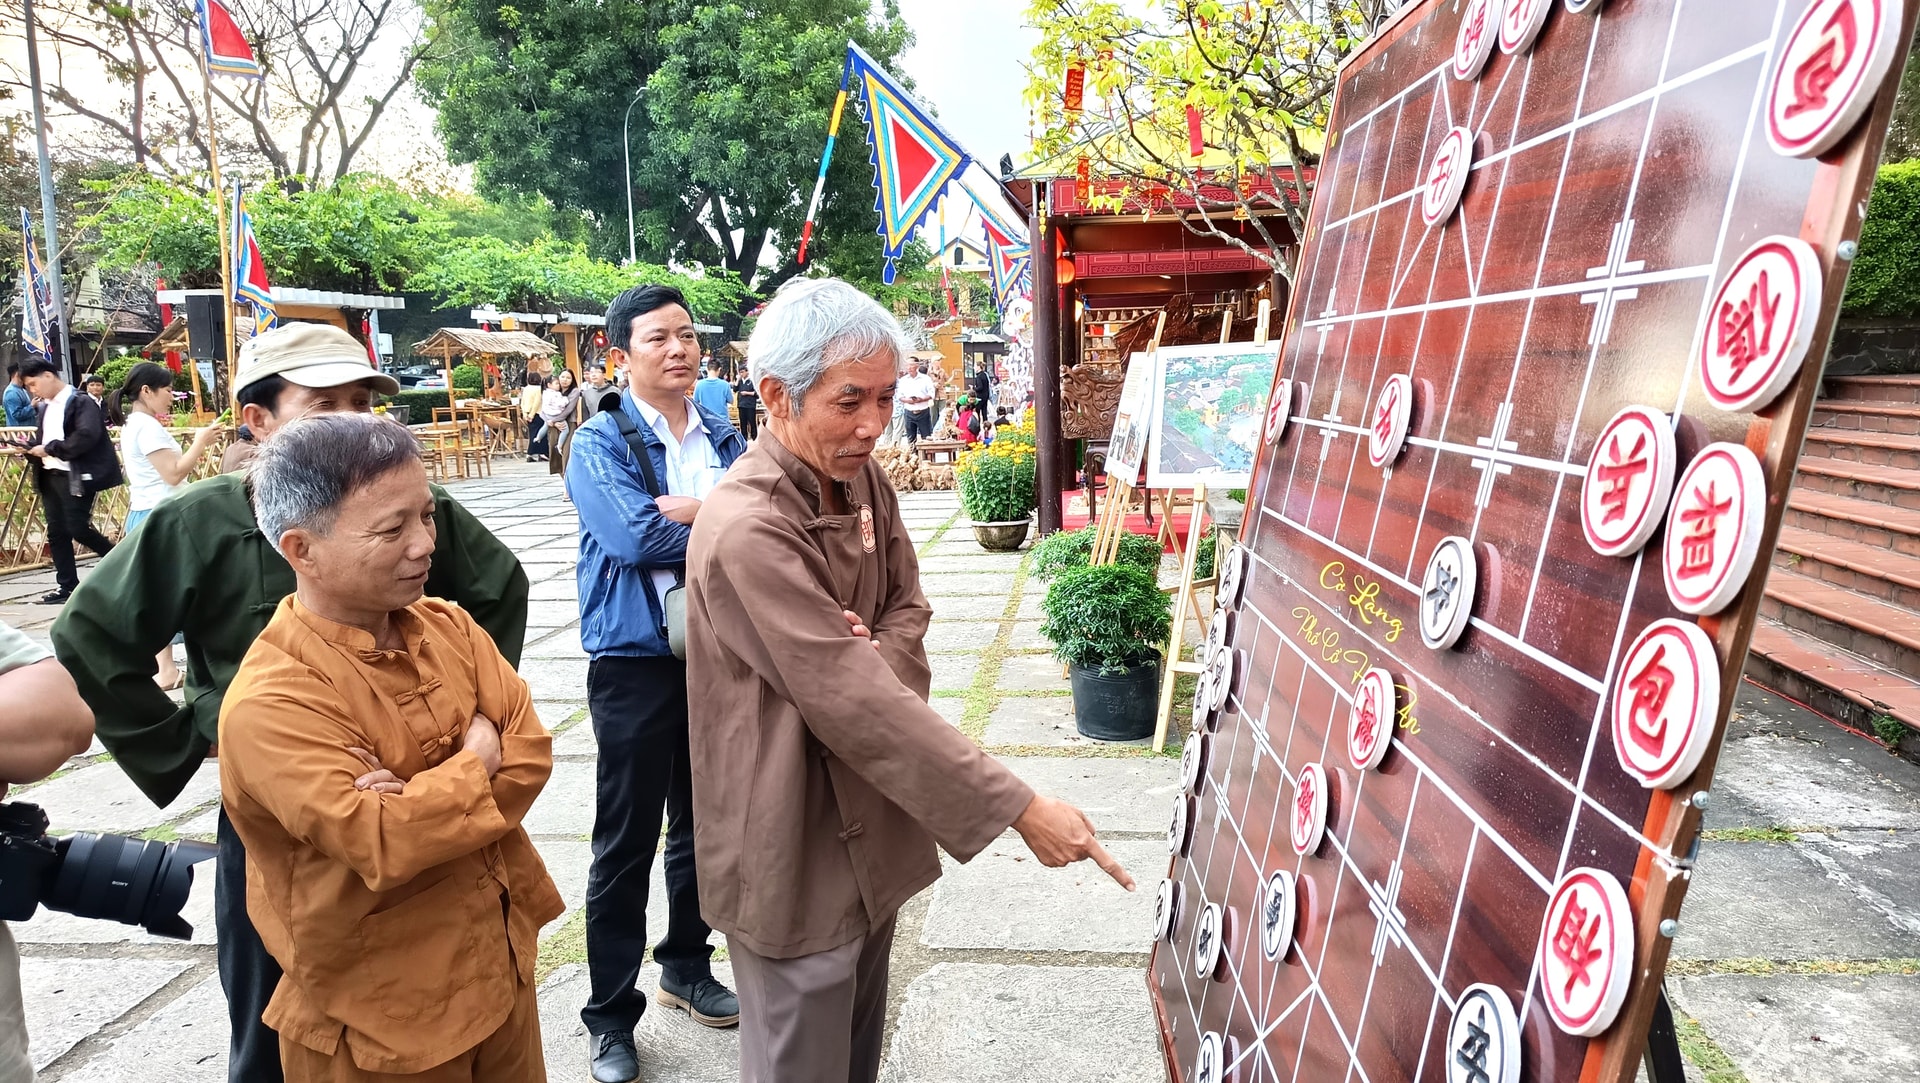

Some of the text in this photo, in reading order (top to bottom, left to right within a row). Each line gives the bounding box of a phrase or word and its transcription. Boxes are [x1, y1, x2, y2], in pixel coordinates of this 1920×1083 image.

[1598, 433, 1647, 526] 兵
[1677, 480, 1732, 580] 相
[1349, 574, 1405, 643] Làng
[1291, 607, 1422, 735] Phố Cổ An
[1629, 643, 1674, 758] 包
[1553, 889, 1602, 1003] 相
